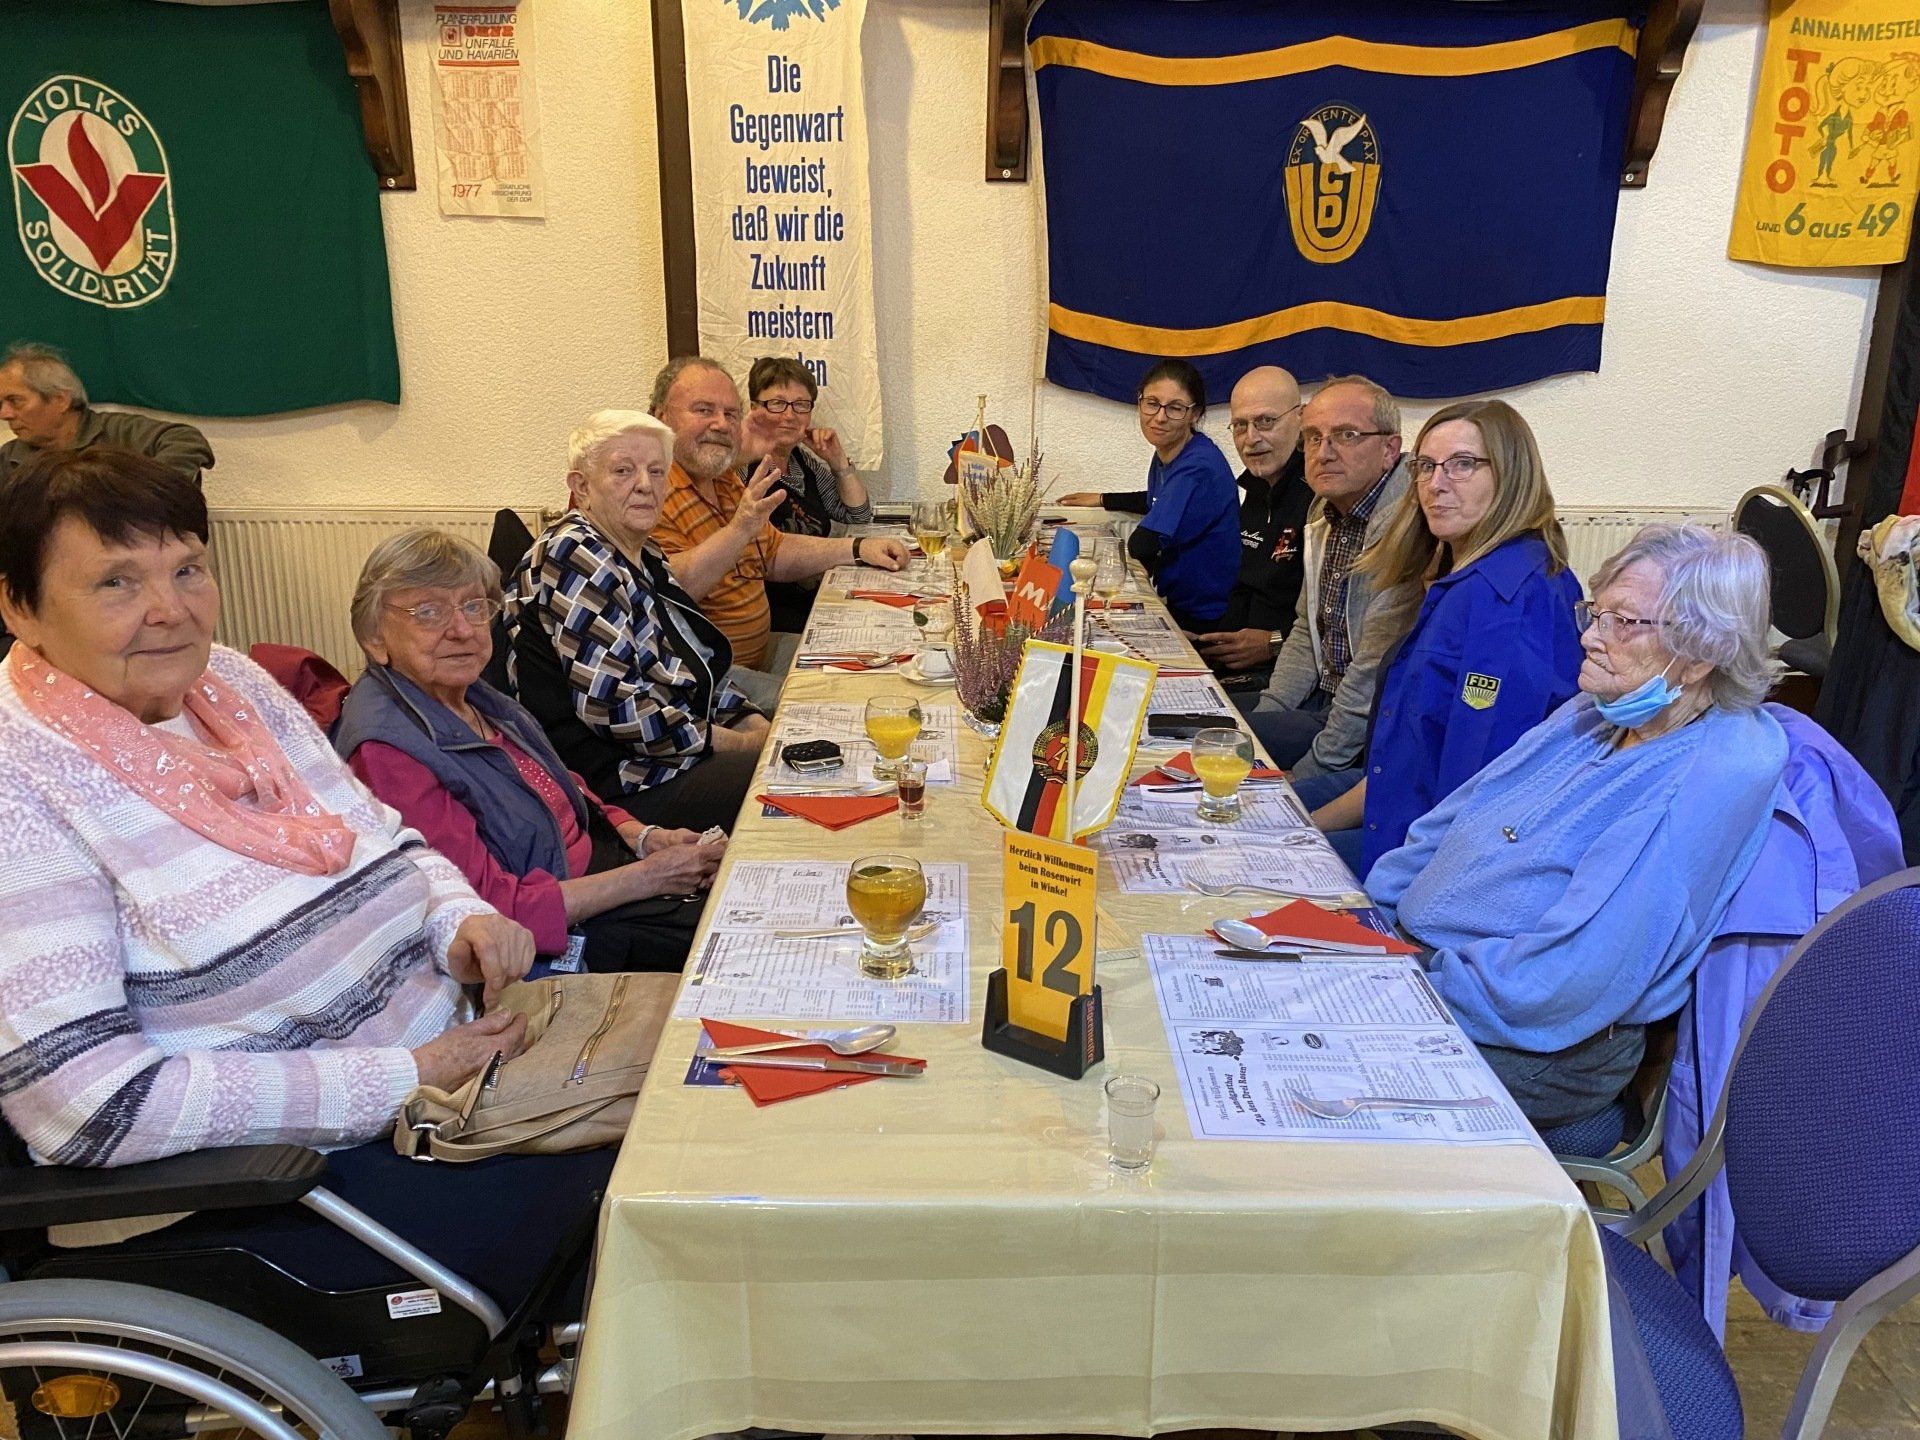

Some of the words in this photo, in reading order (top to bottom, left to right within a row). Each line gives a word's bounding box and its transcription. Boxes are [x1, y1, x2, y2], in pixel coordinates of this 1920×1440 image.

[439, 49, 463, 60] UND
[467, 48, 519, 60] HAVARIEN
[767, 54, 801, 93] Die
[26, 83, 141, 138] VOLKS
[729, 104, 844, 151] Gegenwart
[1291, 148, 1303, 164] EX
[1360, 130, 1375, 160] PAX
[451, 183, 482, 198] 1977
[745, 156, 833, 198] beweist,
[731, 205, 768, 242] daß
[775, 206, 809, 242] wir
[813, 206, 844, 242] die
[1755, 221, 1781, 233] UND
[1784, 202, 1807, 236] 6
[1808, 221, 1853, 239] aus
[1856, 201, 1901, 238] 49
[26, 220, 170, 301] SOLIDARITÄT
[750, 253, 827, 291] Zukunft
[747, 304, 834, 340] meistern
[1468, 675, 1498, 690] FDJ
[1009, 844, 1042, 861] Herzlich
[1043, 853, 1094, 875] Willkommen
[1018, 861, 1038, 874] beim
[1040, 867, 1081, 886] Rosenwirt
[1030, 879, 1039, 889] in
[1040, 881, 1068, 898] Winkel
[1009, 901, 1083, 997] 12
